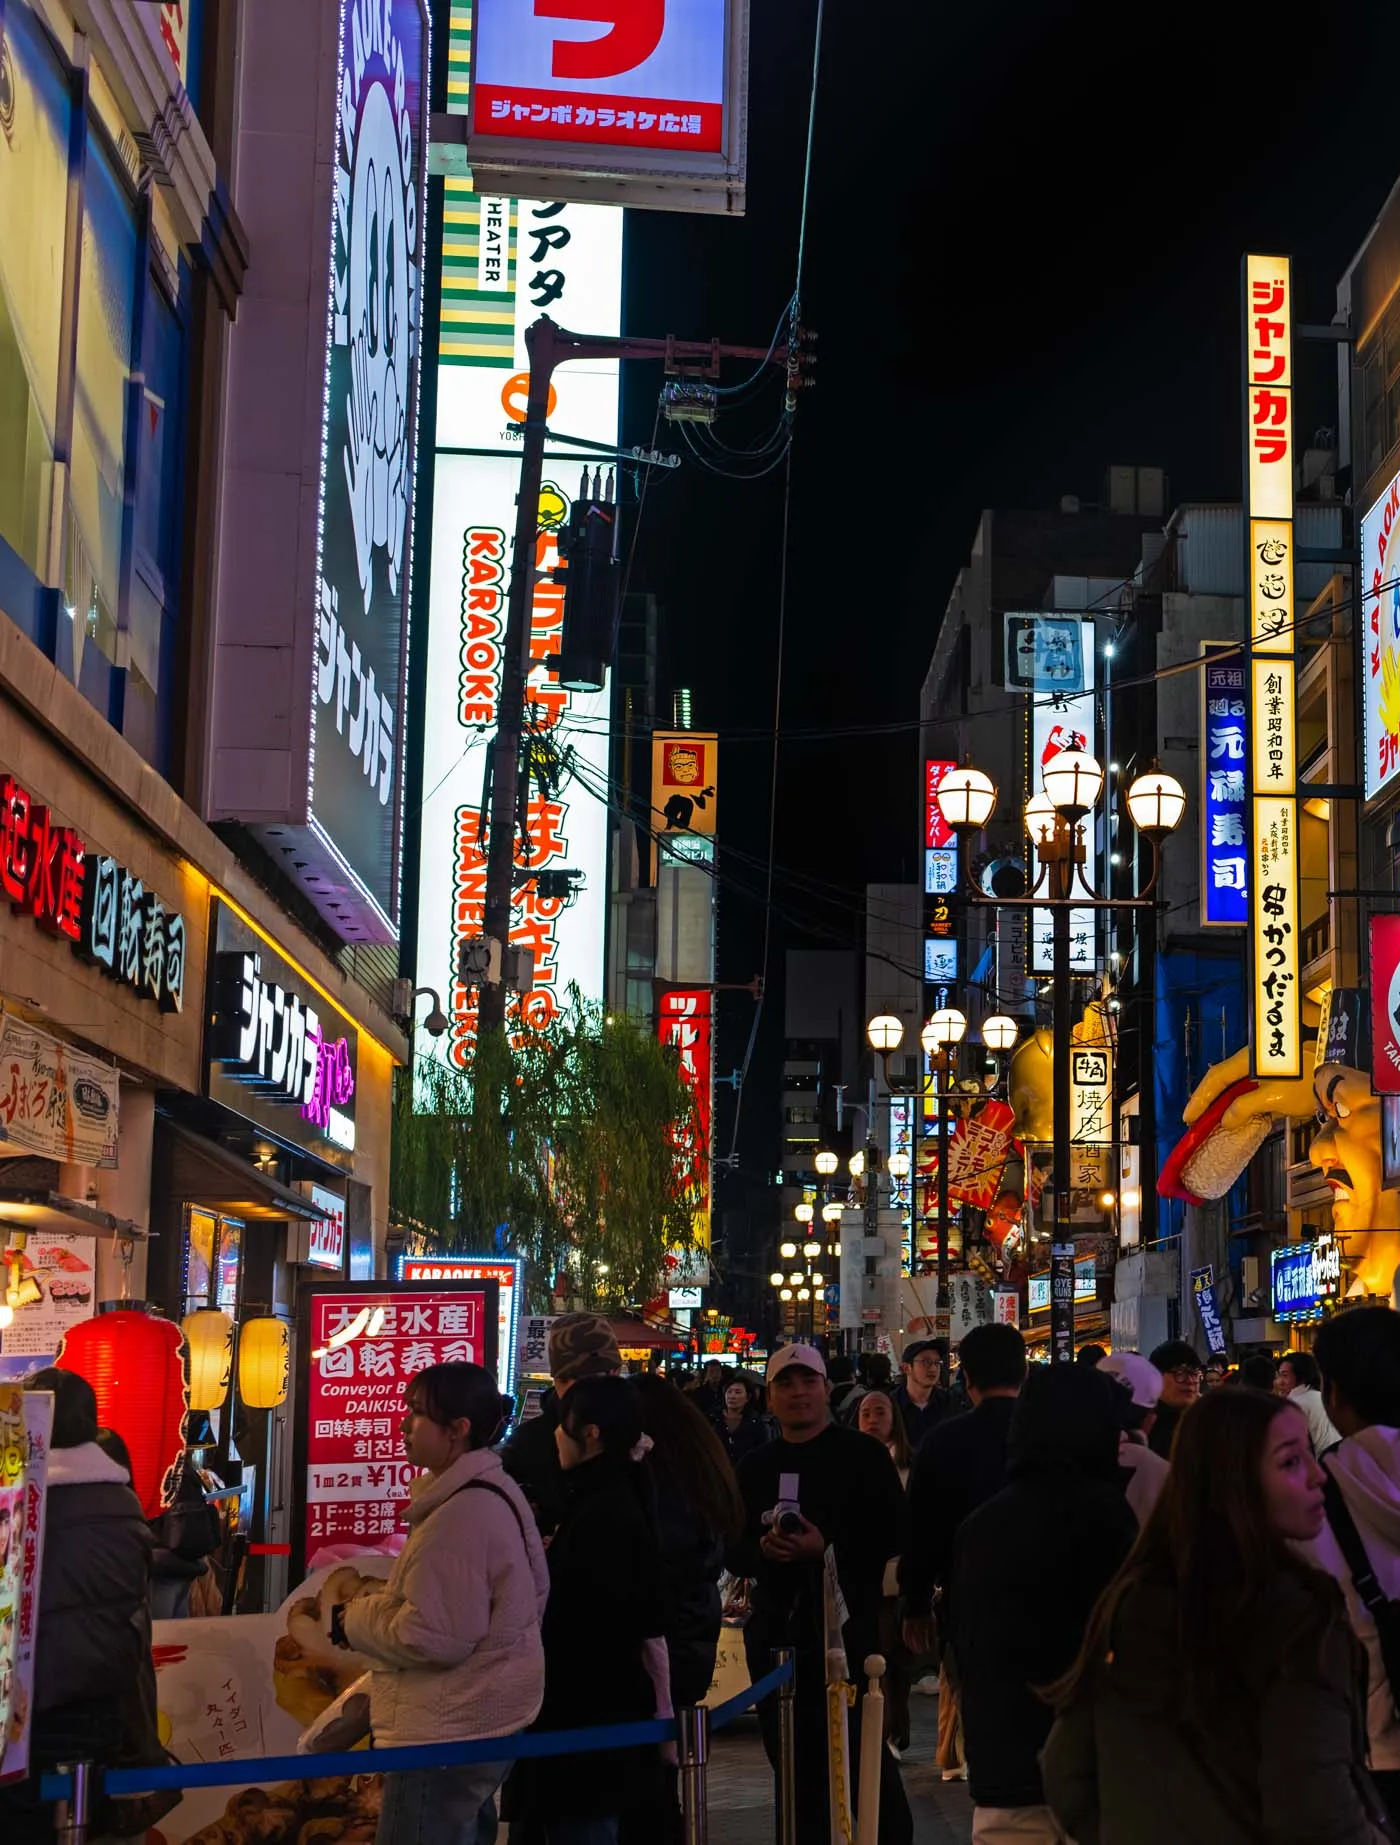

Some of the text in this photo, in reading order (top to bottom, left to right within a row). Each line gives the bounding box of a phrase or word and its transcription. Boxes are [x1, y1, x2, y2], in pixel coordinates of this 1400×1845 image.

[485, 197, 502, 282] HEATER
[1252, 279, 1288, 464] ジャンカラ
[318, 577, 393, 805] ジャンカラ
[464, 532, 499, 723] KARAOKE
[1211, 671, 1242, 685] 元祖
[1264, 673, 1284, 780] 創業昭和四年
[1210, 726, 1245, 890] 元禄寿司
[92, 856, 186, 1013] 回転寿司
[1262, 883, 1293, 1058] 串かつだるま
[240, 953, 318, 1105] ジャンカラ
[315, 1418, 392, 1438] 回转寿司
[321, 1382, 393, 1400] Conveyor
[222, 1678, 247, 1732] イイダコ
